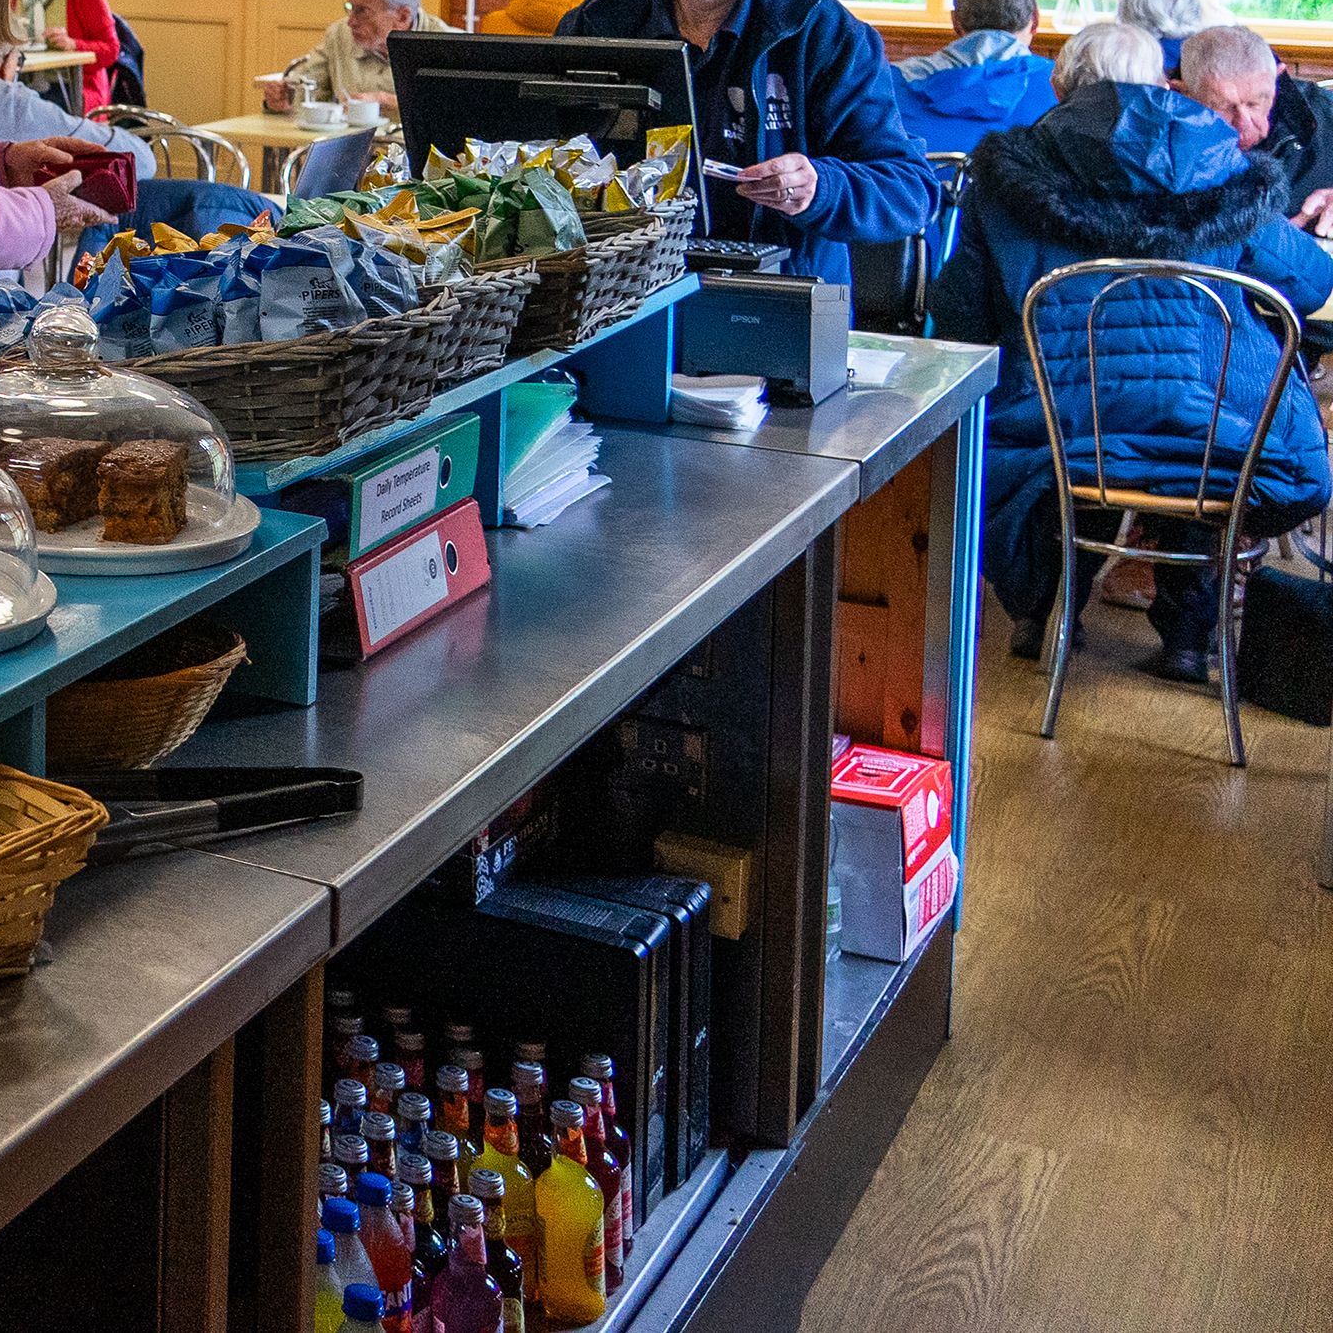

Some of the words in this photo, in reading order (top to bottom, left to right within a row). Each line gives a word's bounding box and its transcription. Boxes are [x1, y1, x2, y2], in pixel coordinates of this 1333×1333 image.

[301, 289, 341, 301] PIPERS
[183, 319, 218, 338] PIPER
[730, 314, 761, 325] EPSON
[376, 477, 393, 498] Daily
[392, 460, 431, 489] Temperature
[380, 500, 403, 524] Record
[401, 492, 423, 512] Sheets
